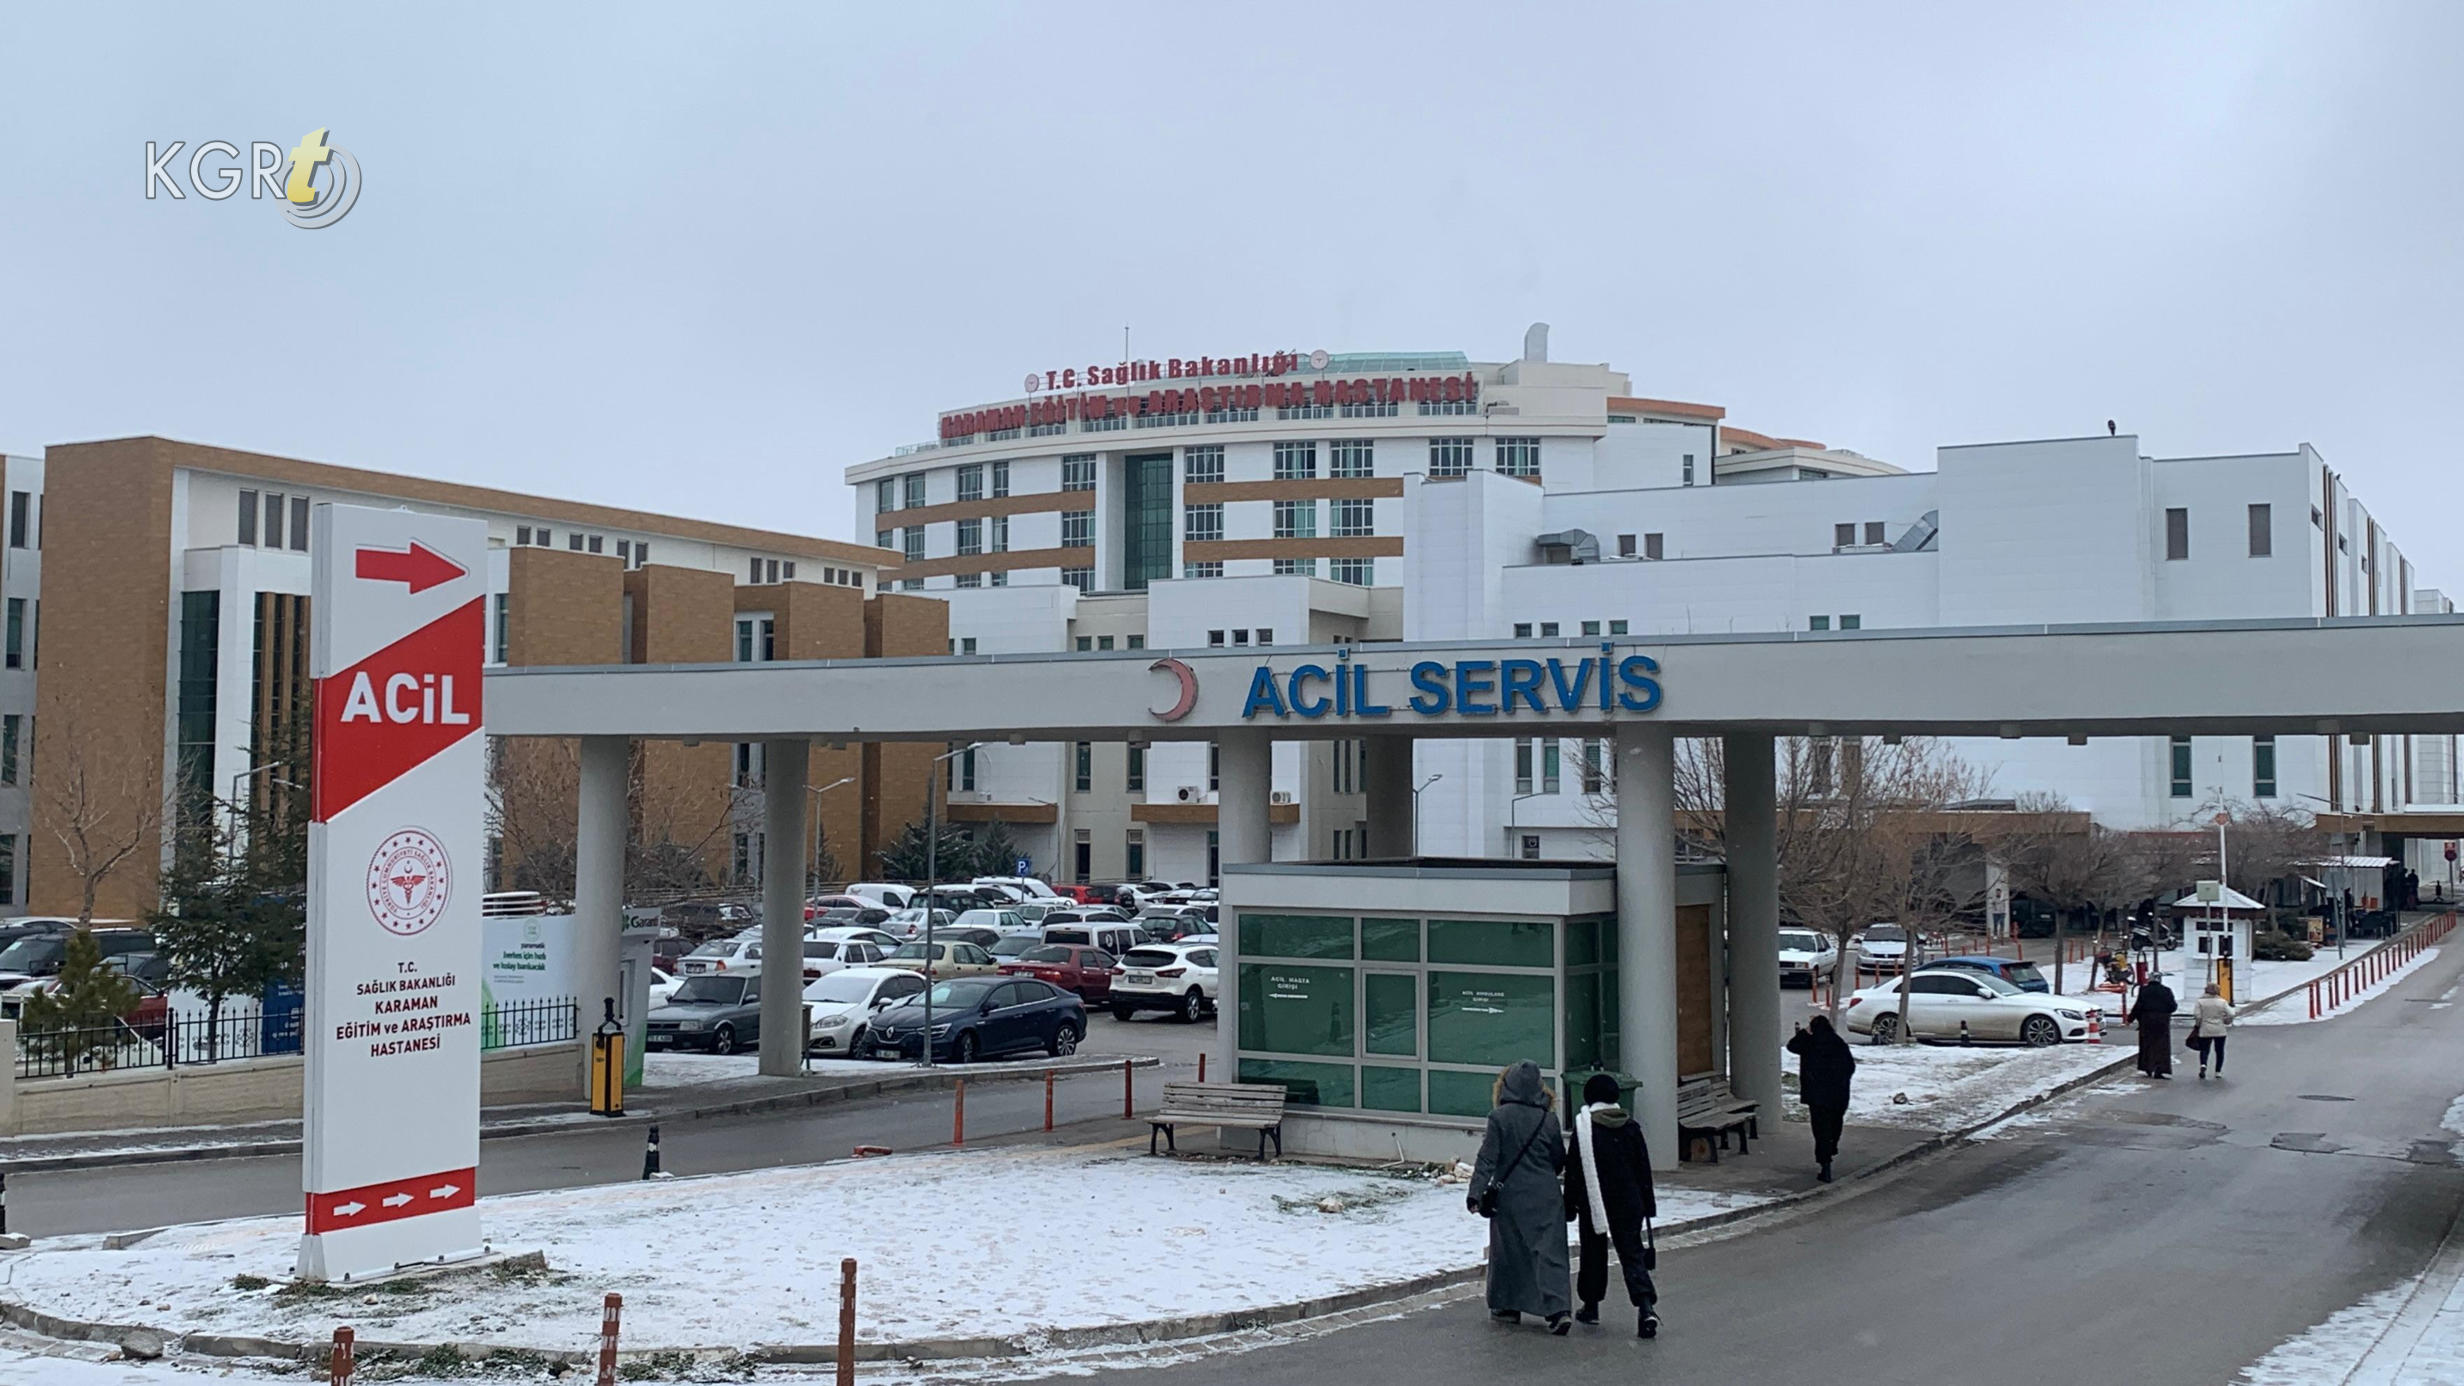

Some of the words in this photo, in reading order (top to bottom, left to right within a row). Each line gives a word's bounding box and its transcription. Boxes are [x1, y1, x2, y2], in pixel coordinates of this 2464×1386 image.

[1087, 360, 1162, 386] Sağlık
[1242, 648, 1393, 719] ACİL
[1408, 641, 1665, 716] SERVİS
[398, 961, 418, 974] T.C.
[356, 980, 397, 996] SAĞLIK
[399, 972, 456, 992] BAKANLIĞI
[375, 995, 438, 1015] KARAMAN
[336, 1020, 381, 1041] EĞİTİM
[384, 1023, 399, 1035] ve
[401, 1012, 471, 1033] ARAŞTIRMA
[370, 1033, 441, 1058] HASTANESİ
